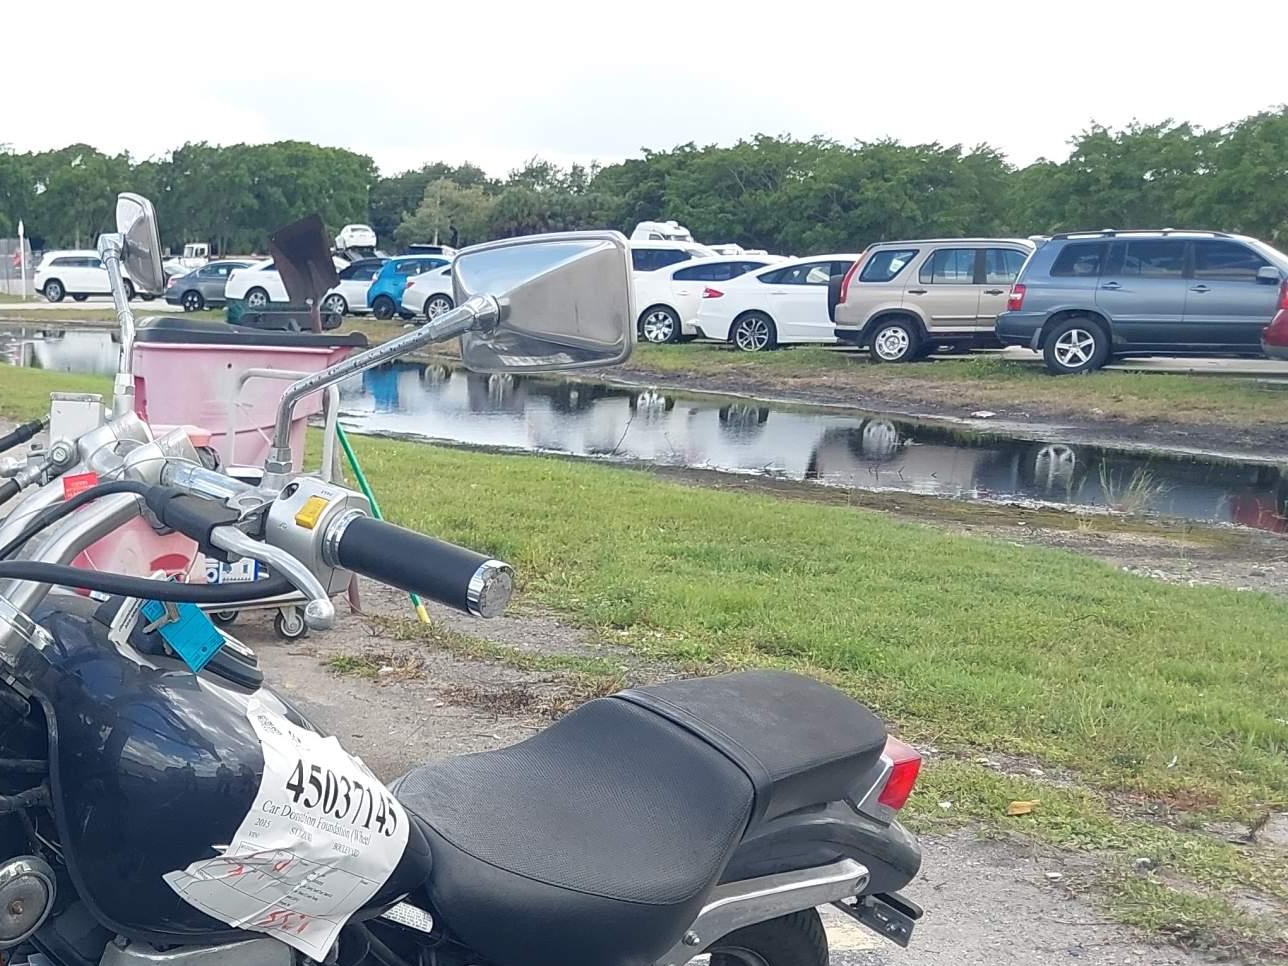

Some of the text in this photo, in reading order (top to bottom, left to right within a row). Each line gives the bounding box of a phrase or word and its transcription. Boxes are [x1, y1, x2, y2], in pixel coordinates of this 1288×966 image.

[286, 758, 397, 837] 45037145
[262, 800, 281, 815] Car
[255, 818, 272, 829] 2015
